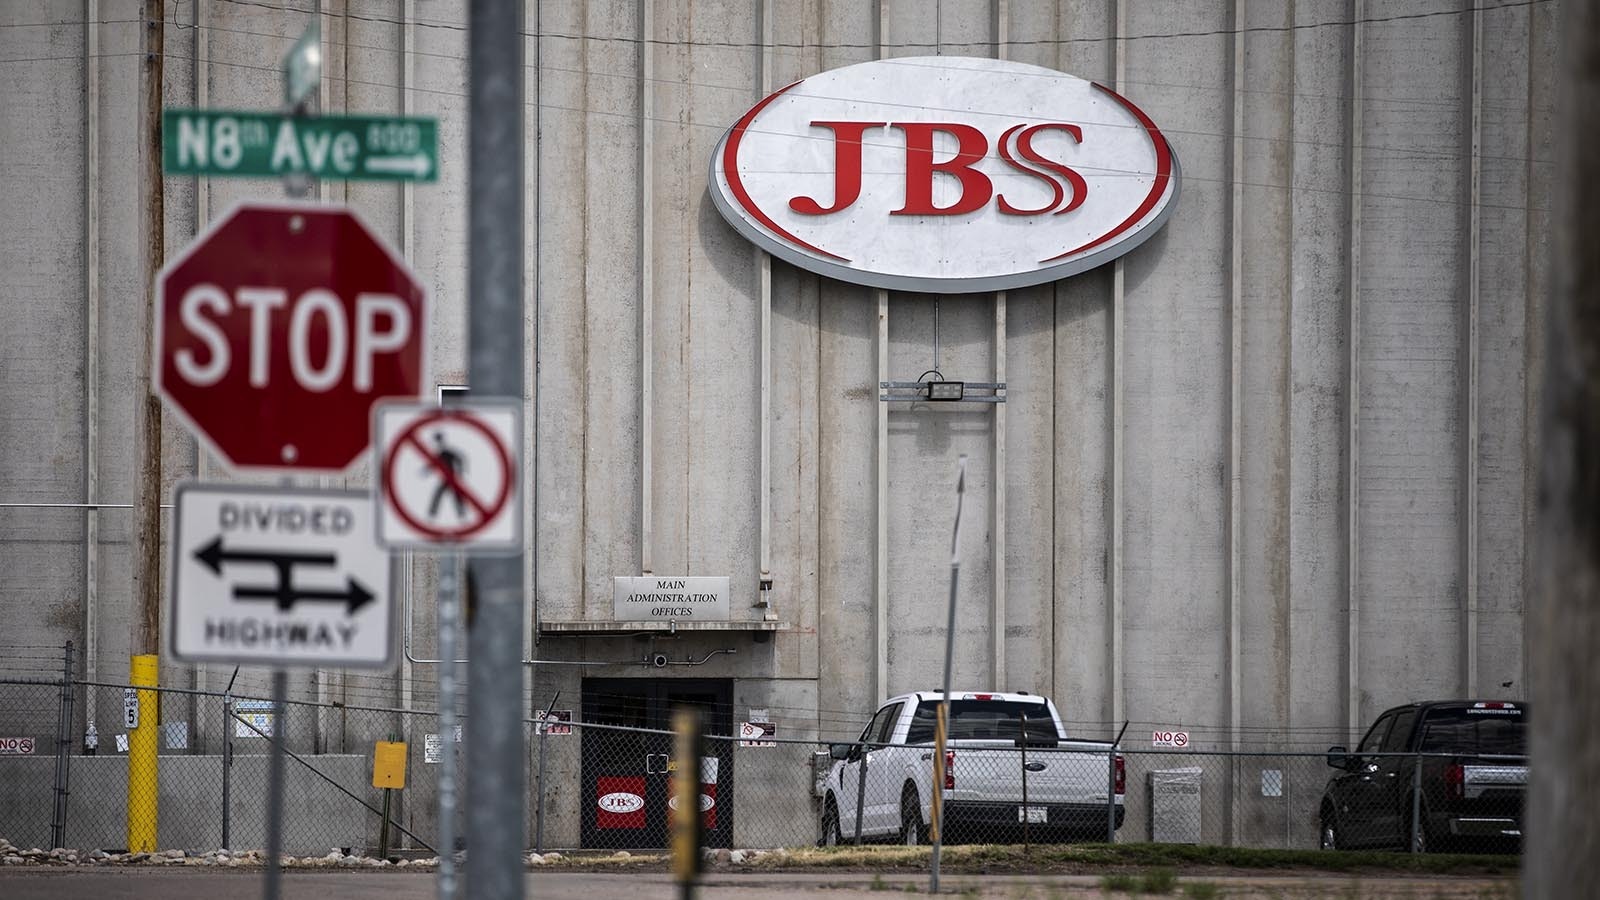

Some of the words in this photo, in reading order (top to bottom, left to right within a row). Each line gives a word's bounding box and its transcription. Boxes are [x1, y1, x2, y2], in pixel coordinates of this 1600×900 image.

[271, 119, 359, 172] Ave
[788, 120, 1088, 216] JBS
[173, 283, 413, 393] STOP
[220, 501, 354, 536] DIVIDED
[657, 581, 686, 589] MAIN
[627, 594, 717, 603] ADMINISTRATION
[652, 607, 692, 616] OFFICES
[205, 618, 358, 648] HIGHWAY
[128, 709, 135, 724] 5
[1154, 732, 1172, 741] NO
[0, 739, 18, 749] NO
[607, 798, 635, 807] JBS
